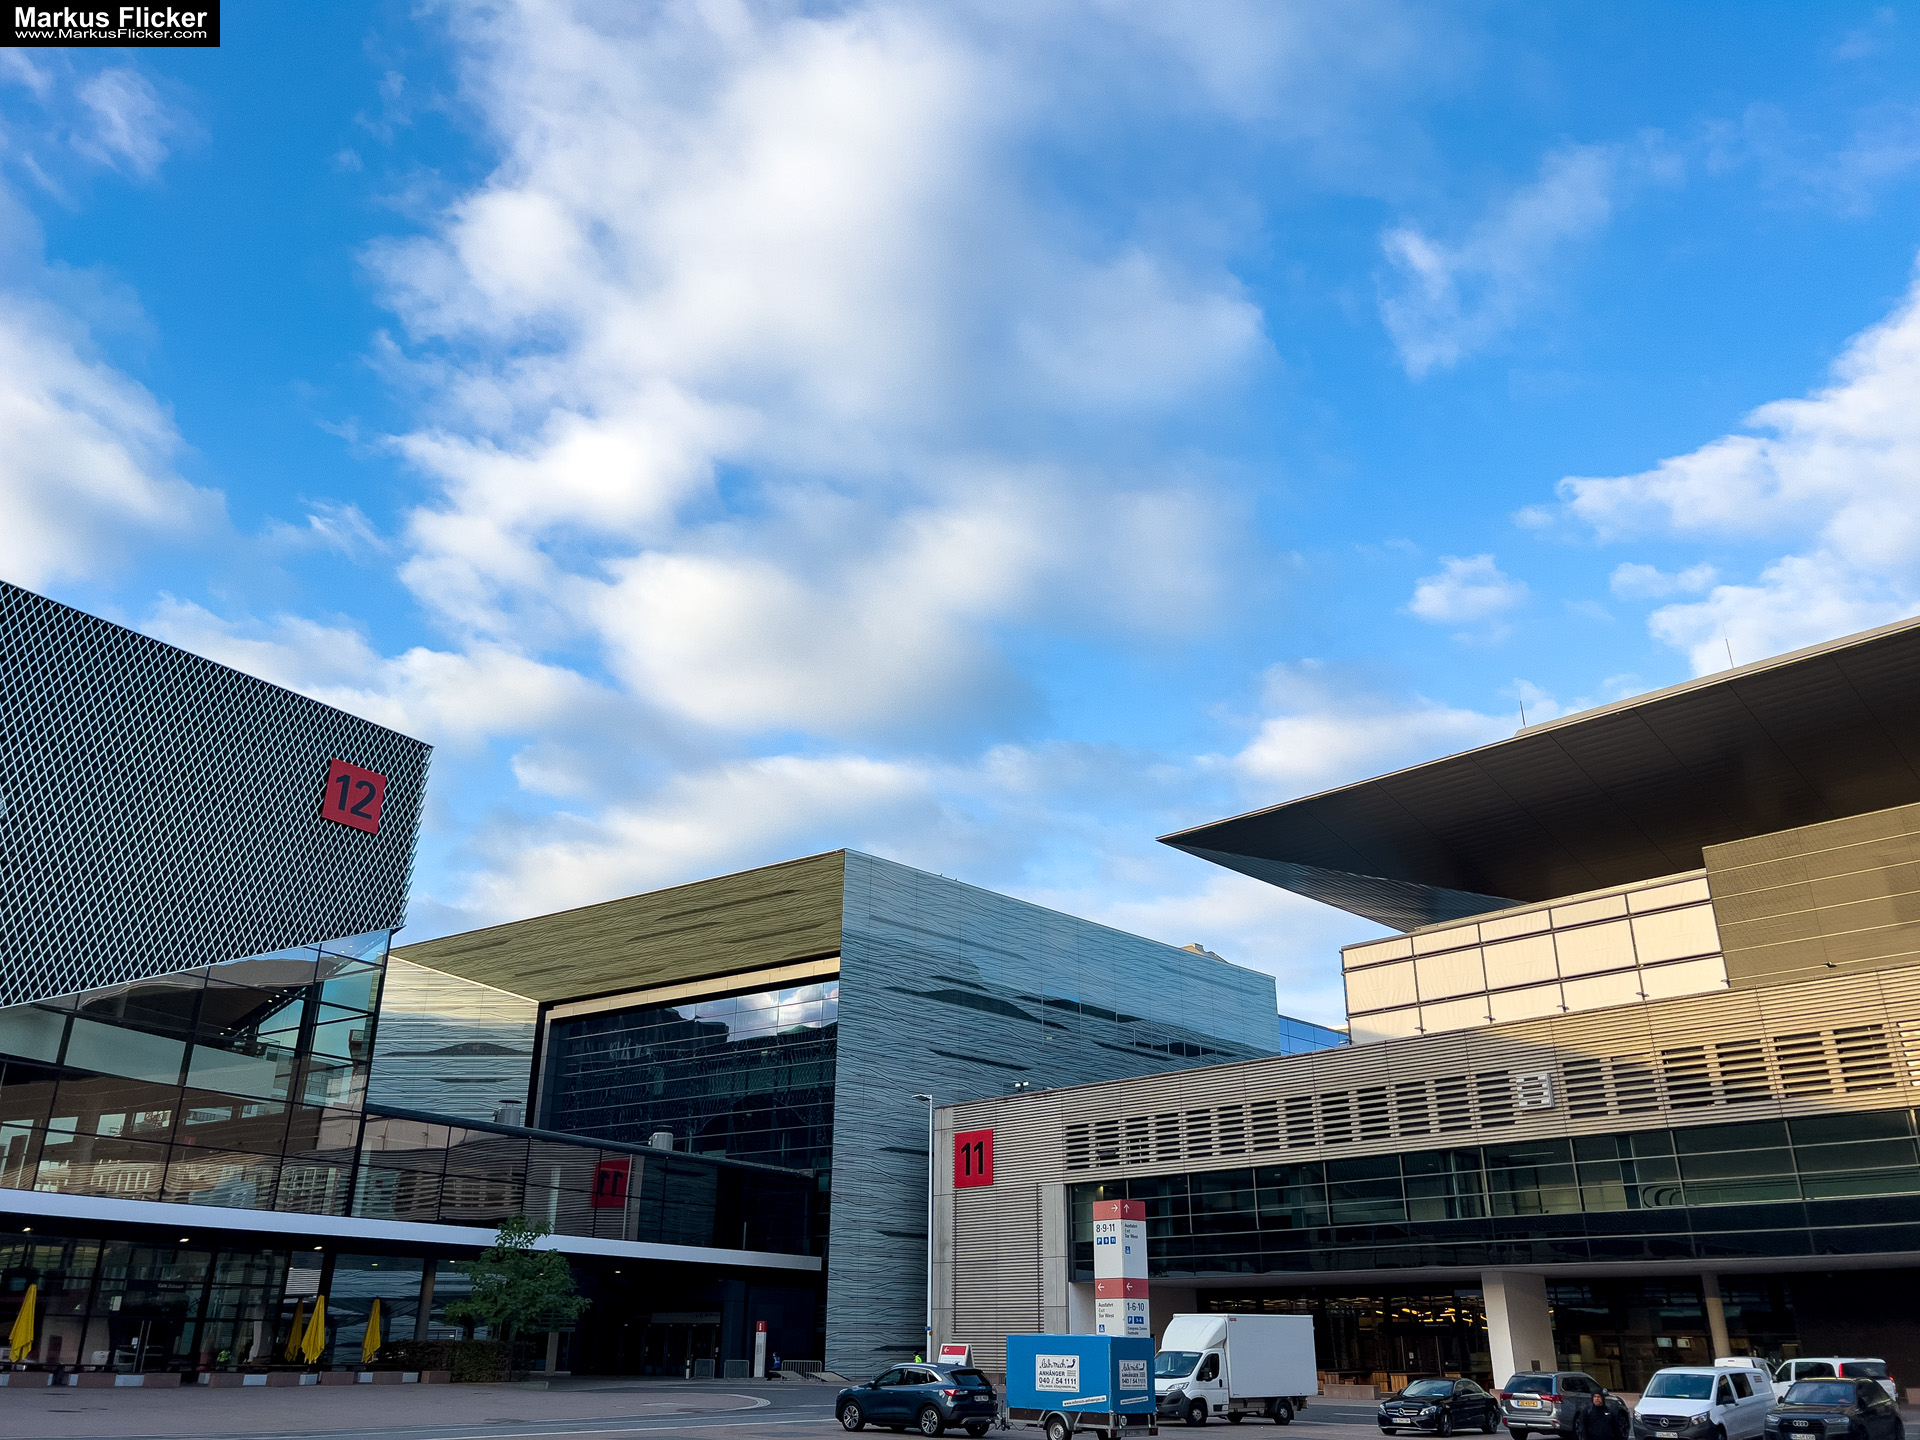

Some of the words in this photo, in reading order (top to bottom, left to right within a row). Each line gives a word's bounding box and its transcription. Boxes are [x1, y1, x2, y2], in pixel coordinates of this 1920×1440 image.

[336, 774, 377, 820] 12
[961, 1141, 984, 1176] 11
[1038, 1376, 1051, 1384] 040
[1039, 1369, 1066, 1377] ANHÄNGER
